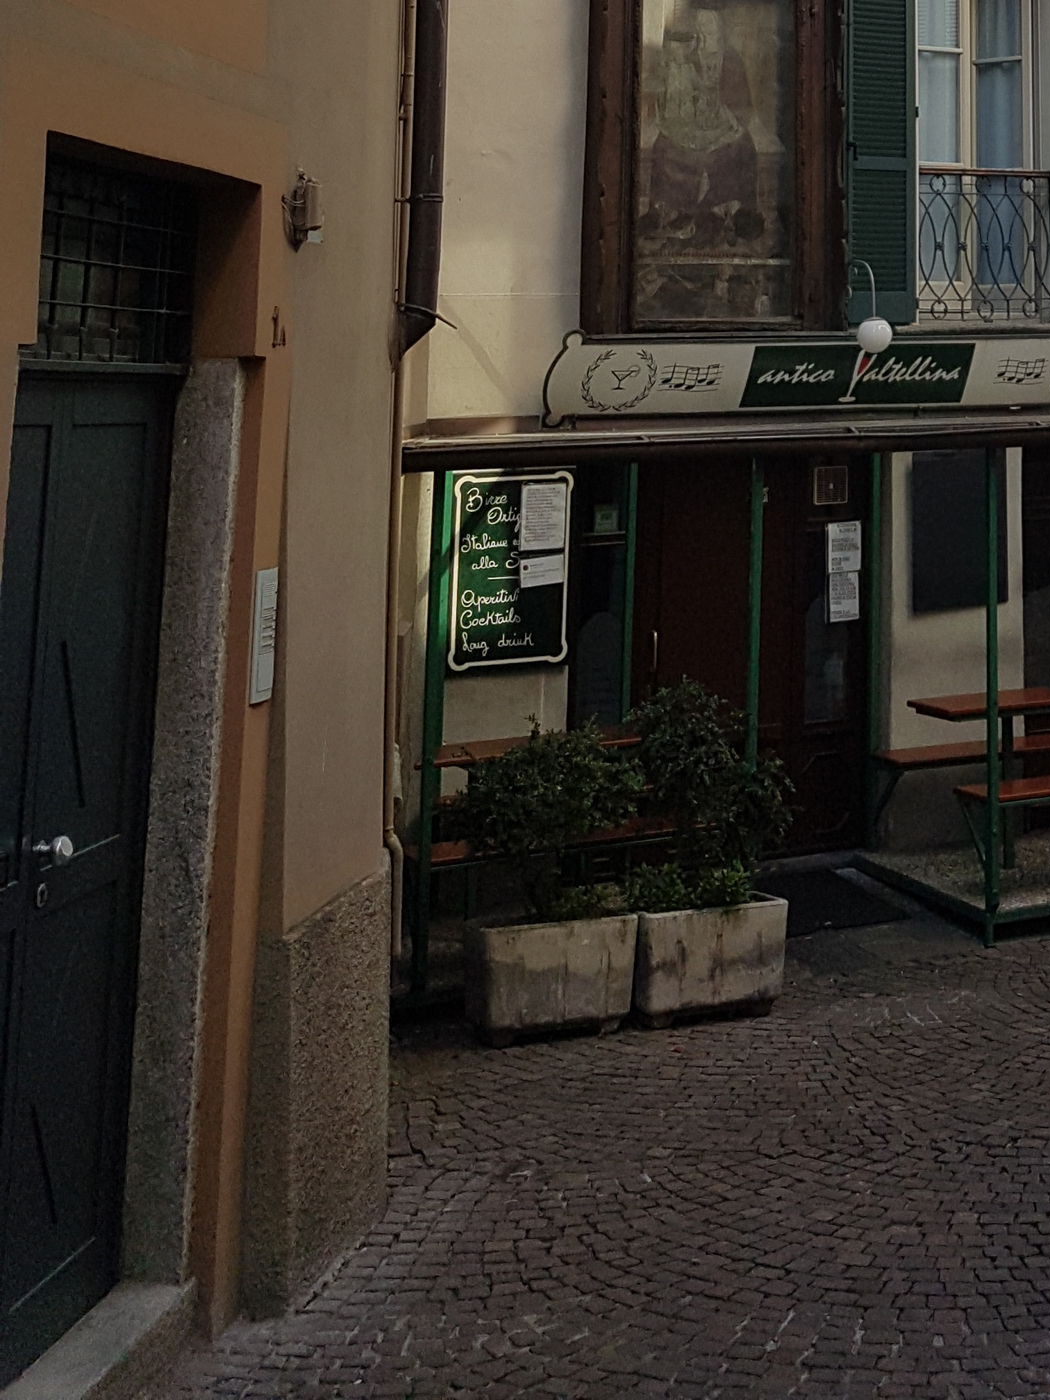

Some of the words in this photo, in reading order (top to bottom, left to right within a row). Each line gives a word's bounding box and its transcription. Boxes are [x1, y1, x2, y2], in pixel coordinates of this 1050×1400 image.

[838, 349, 961, 403] Valtellina
[465, 488, 508, 512] Birre
[461, 533, 508, 552] Italiane
[472, 556, 498, 571] alla
[462, 633, 489, 656] Long
